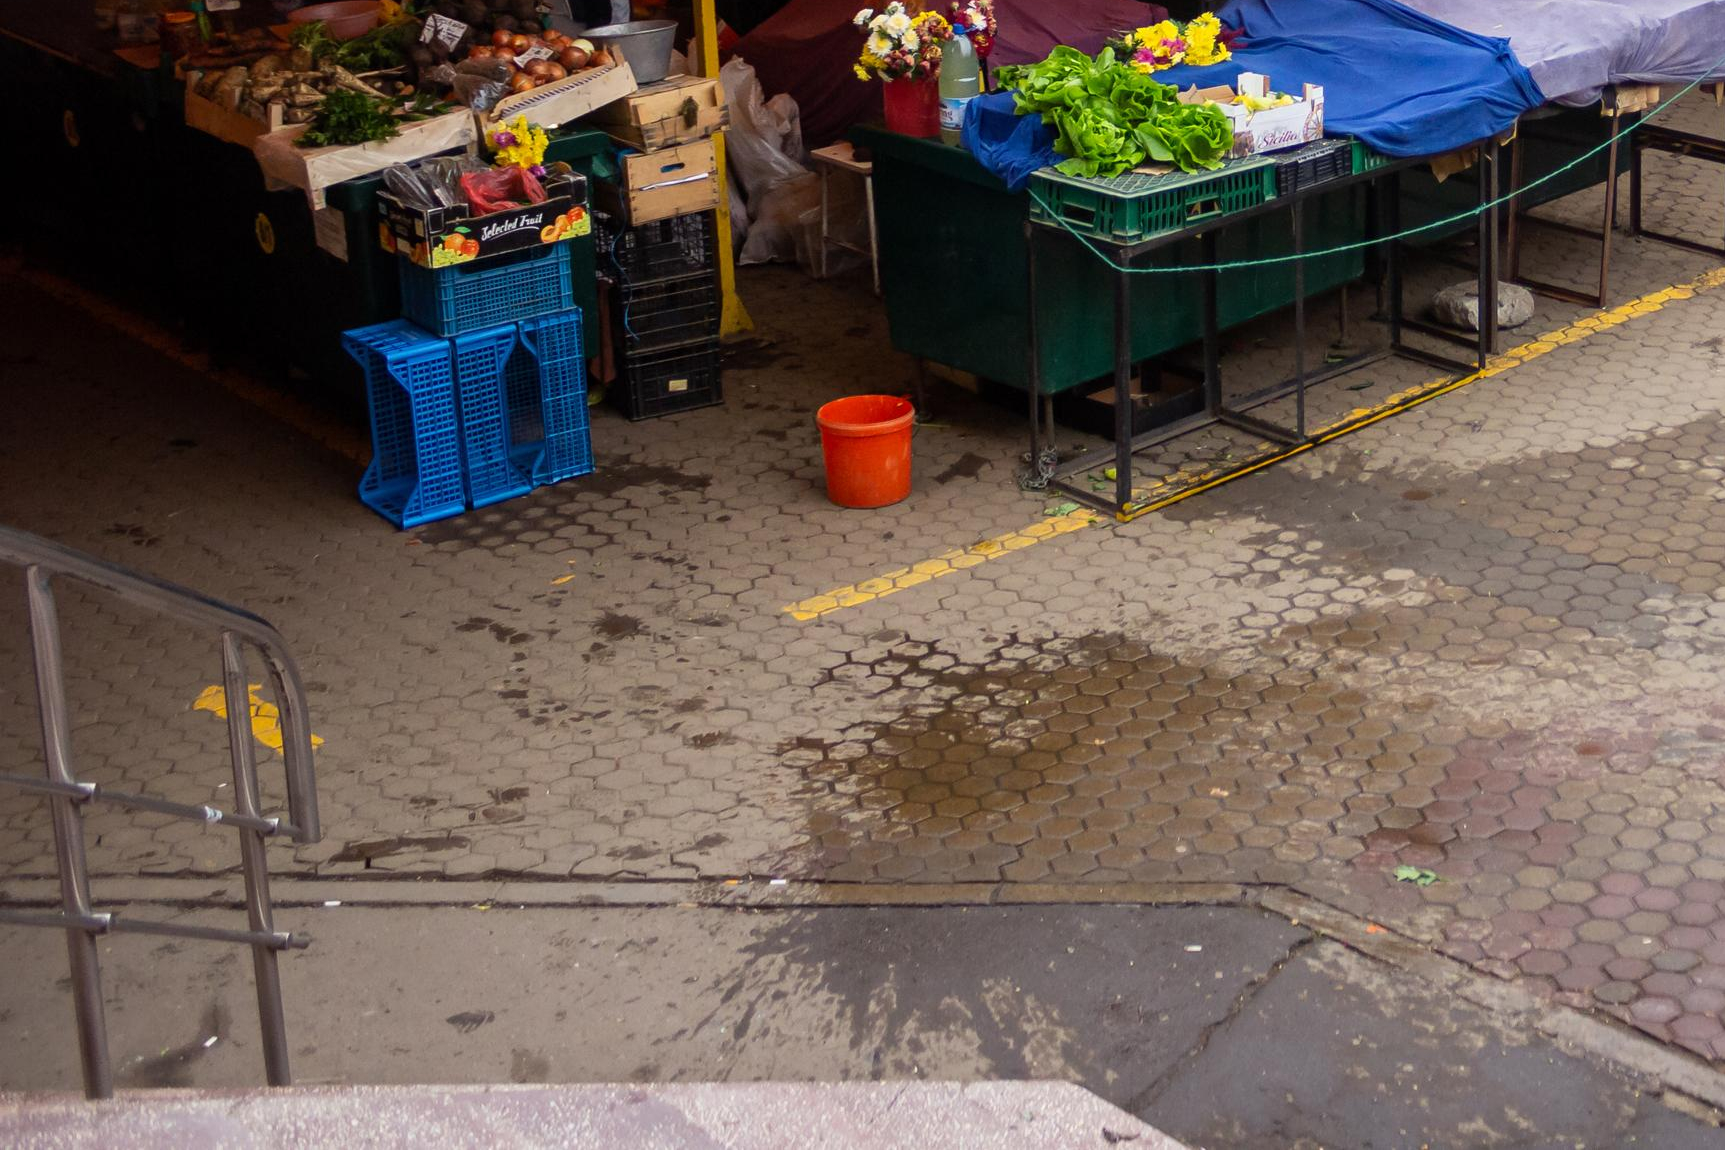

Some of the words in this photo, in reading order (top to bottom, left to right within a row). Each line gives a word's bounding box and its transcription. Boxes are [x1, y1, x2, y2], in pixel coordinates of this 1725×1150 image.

[1258, 130, 1298, 149] Sicilia
[481, 219, 518, 240] Selected
[519, 213, 543, 227] Fruit
